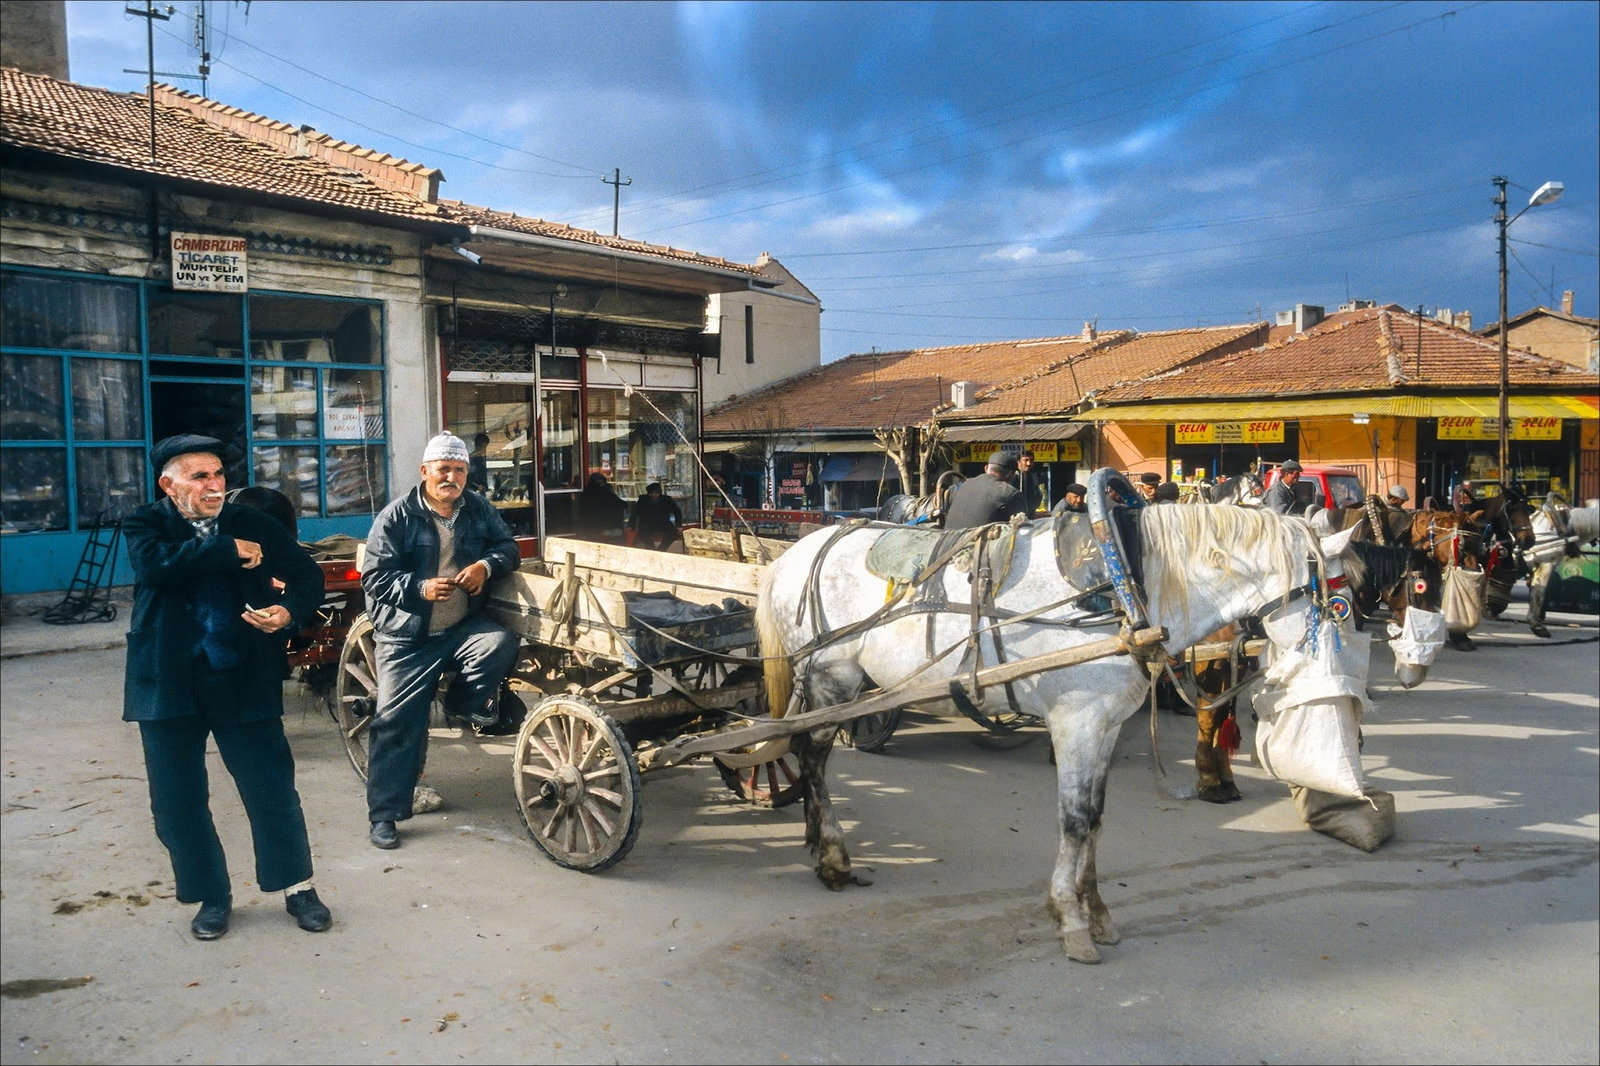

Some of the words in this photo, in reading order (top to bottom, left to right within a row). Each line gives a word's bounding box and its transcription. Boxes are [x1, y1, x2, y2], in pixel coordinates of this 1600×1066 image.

[173, 238, 247, 252] CAMBAZLAR
[179, 251, 239, 265] TİCARET
[179, 263, 239, 273] MUHTELİF
[176, 272, 196, 281] UN
[212, 273, 244, 283] YEM
